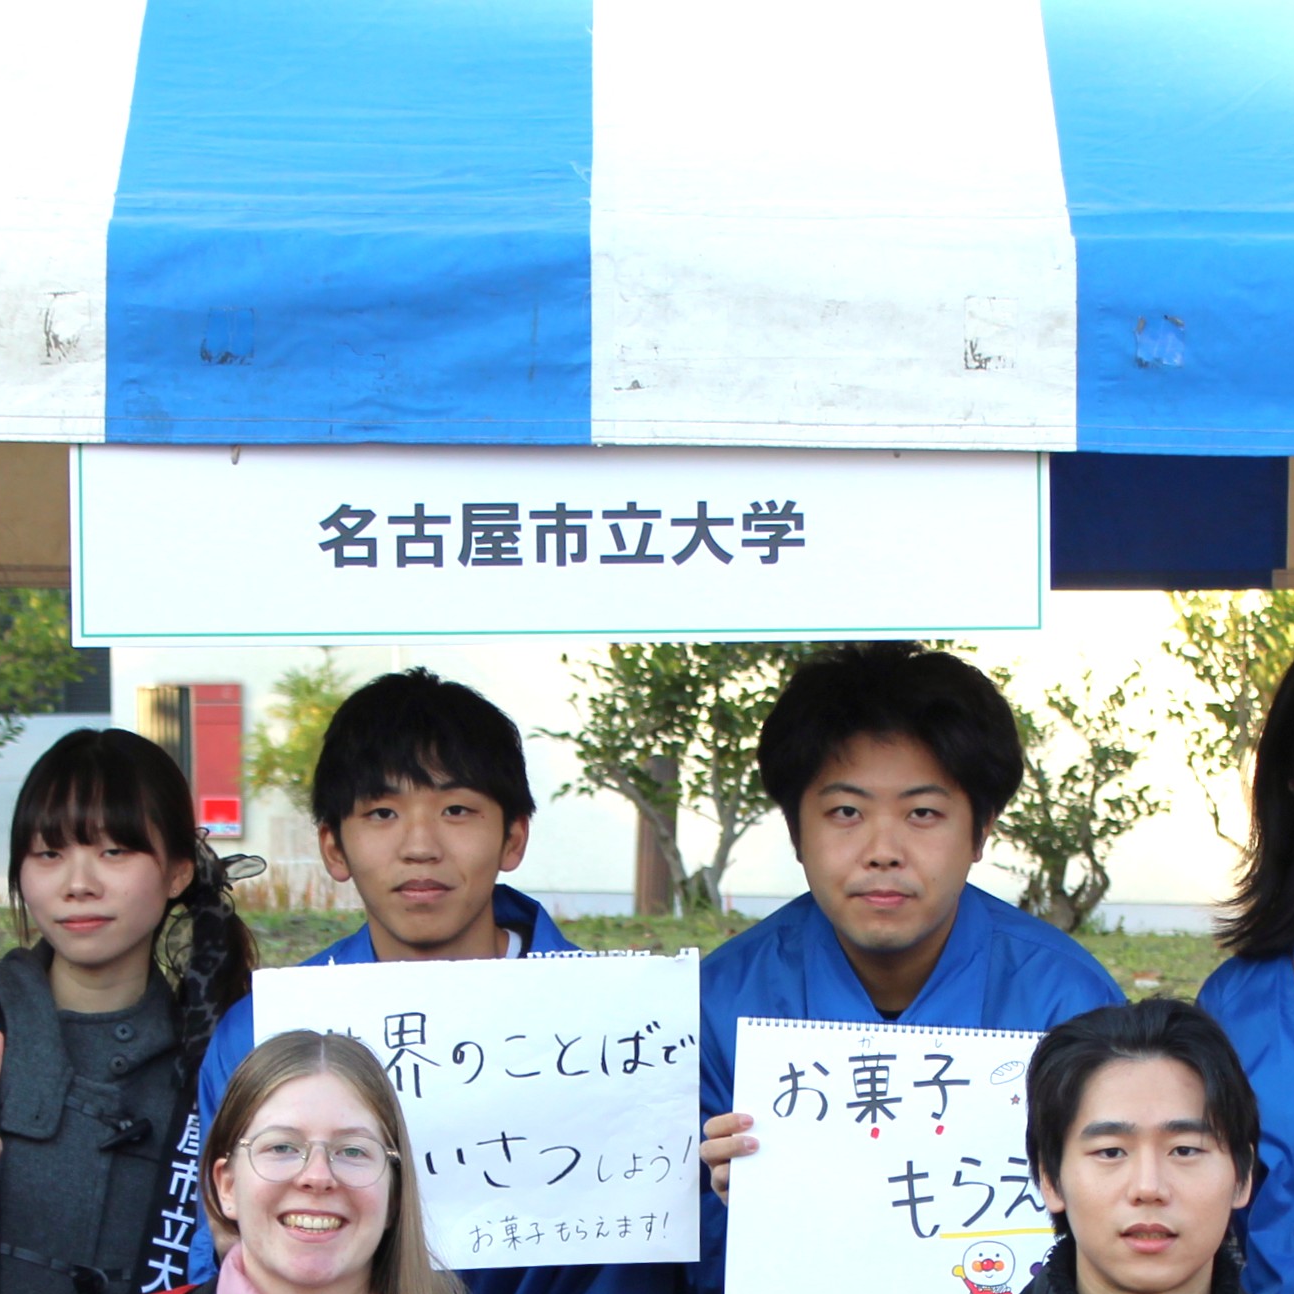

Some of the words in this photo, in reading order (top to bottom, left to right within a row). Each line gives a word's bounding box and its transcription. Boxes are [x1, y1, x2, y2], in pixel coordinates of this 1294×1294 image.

[317, 500, 806, 567] 名古屋市立大学
[326, 1011, 696, 1098] 界のことばで
[772, 1052, 971, 1124] お菓子
